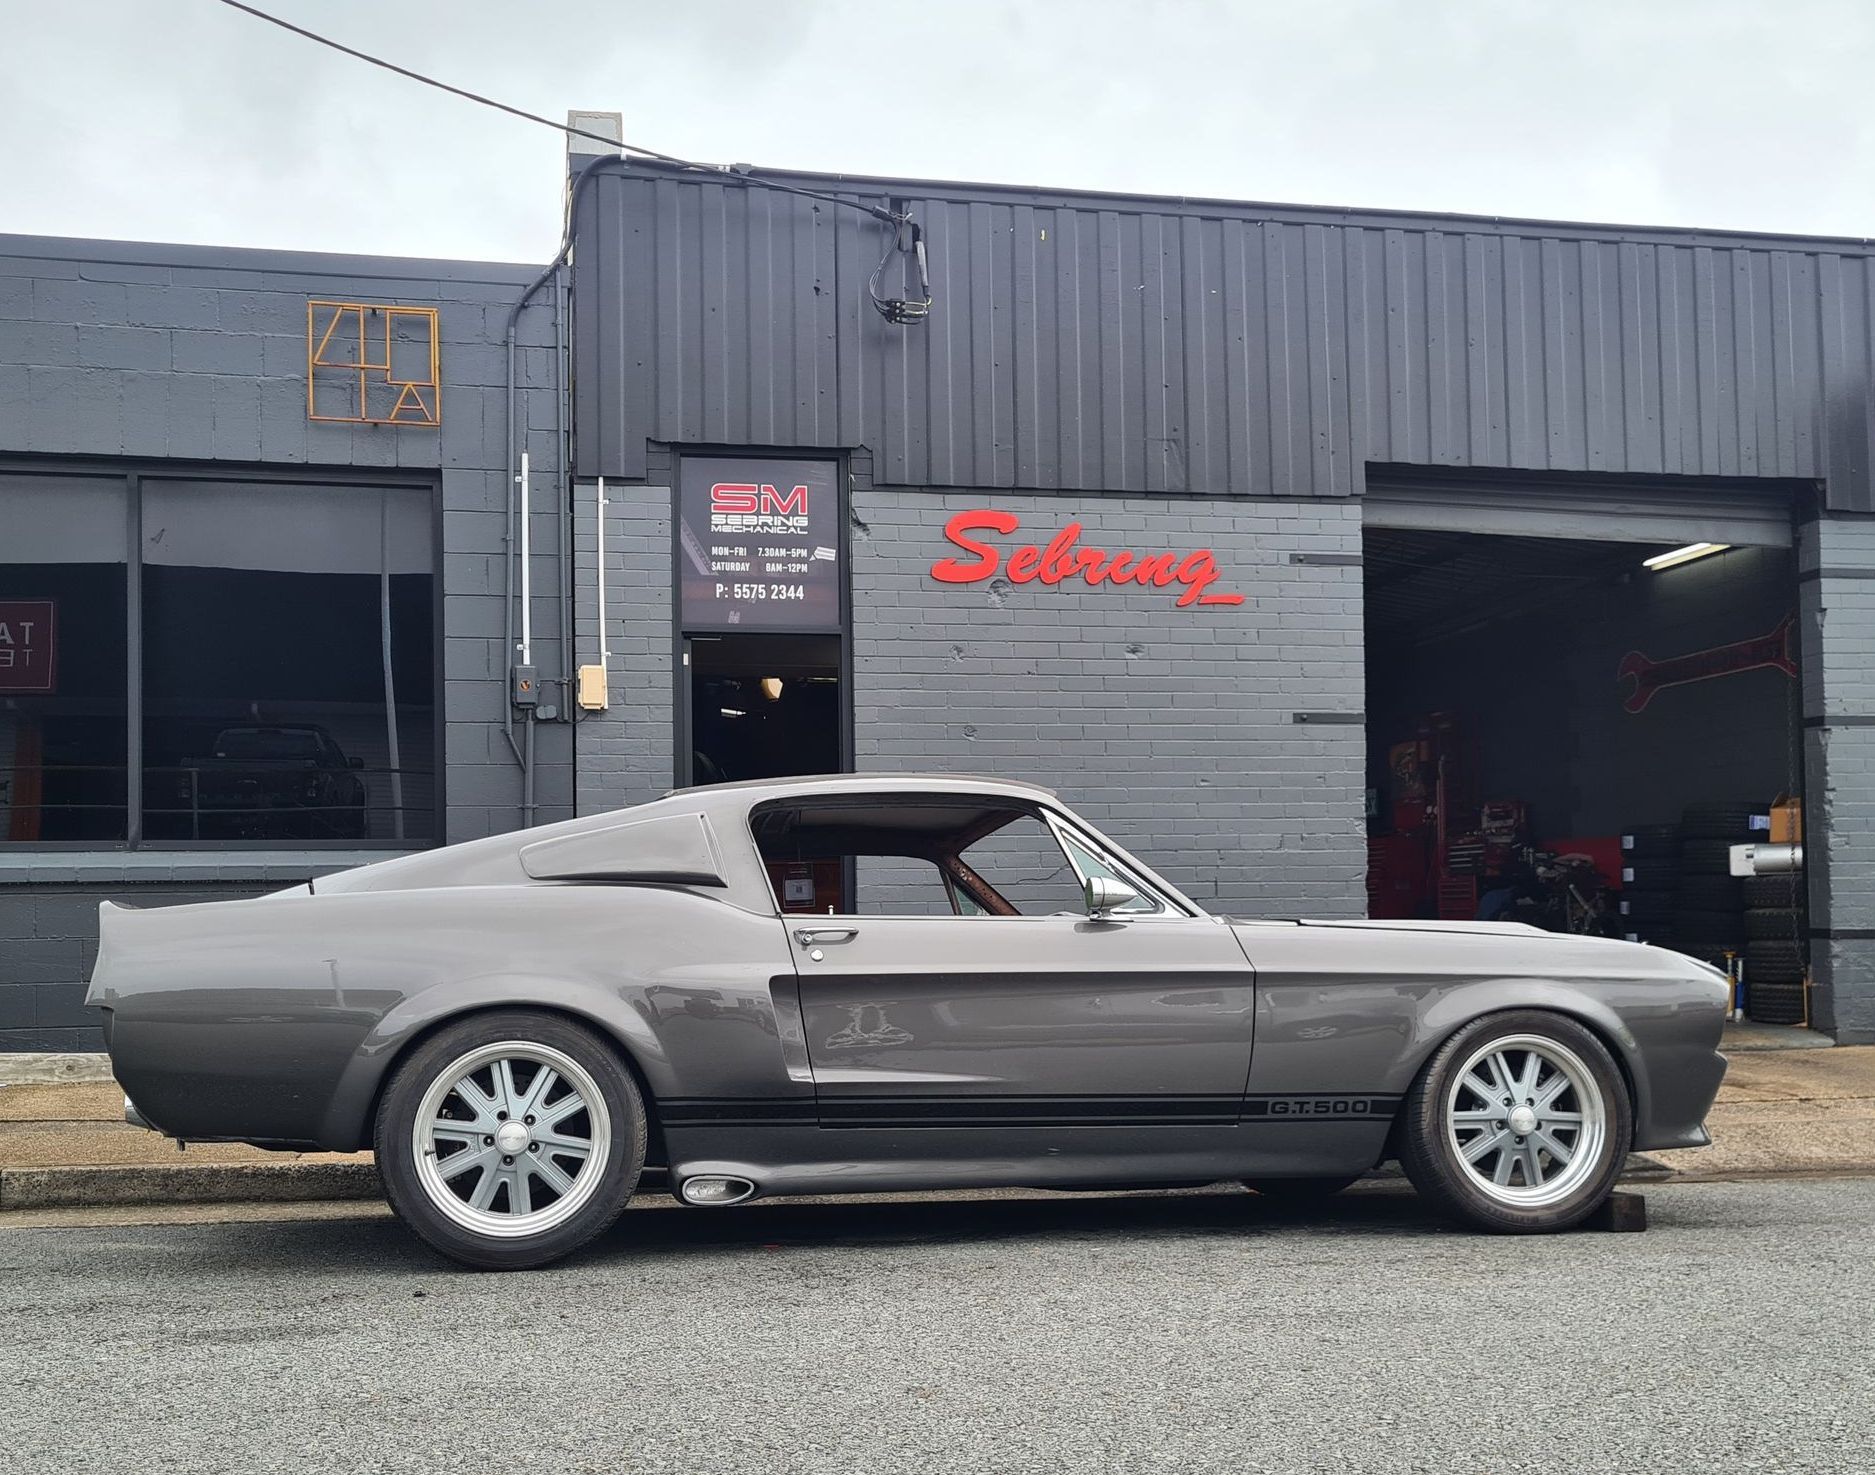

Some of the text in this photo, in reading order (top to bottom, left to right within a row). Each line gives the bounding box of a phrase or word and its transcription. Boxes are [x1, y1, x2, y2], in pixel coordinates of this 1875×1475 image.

[711, 514, 808, 527] SEBRING
[711, 525, 808, 534] MECHANICAL
[711, 546, 808, 558] MON-FRI 7.30AM-5PM
[931, 509, 1245, 607] Sebring
[711, 561, 808, 573] SATURDAY 8AM-12PM
[715, 583, 804, 600] P: 5575 2344
